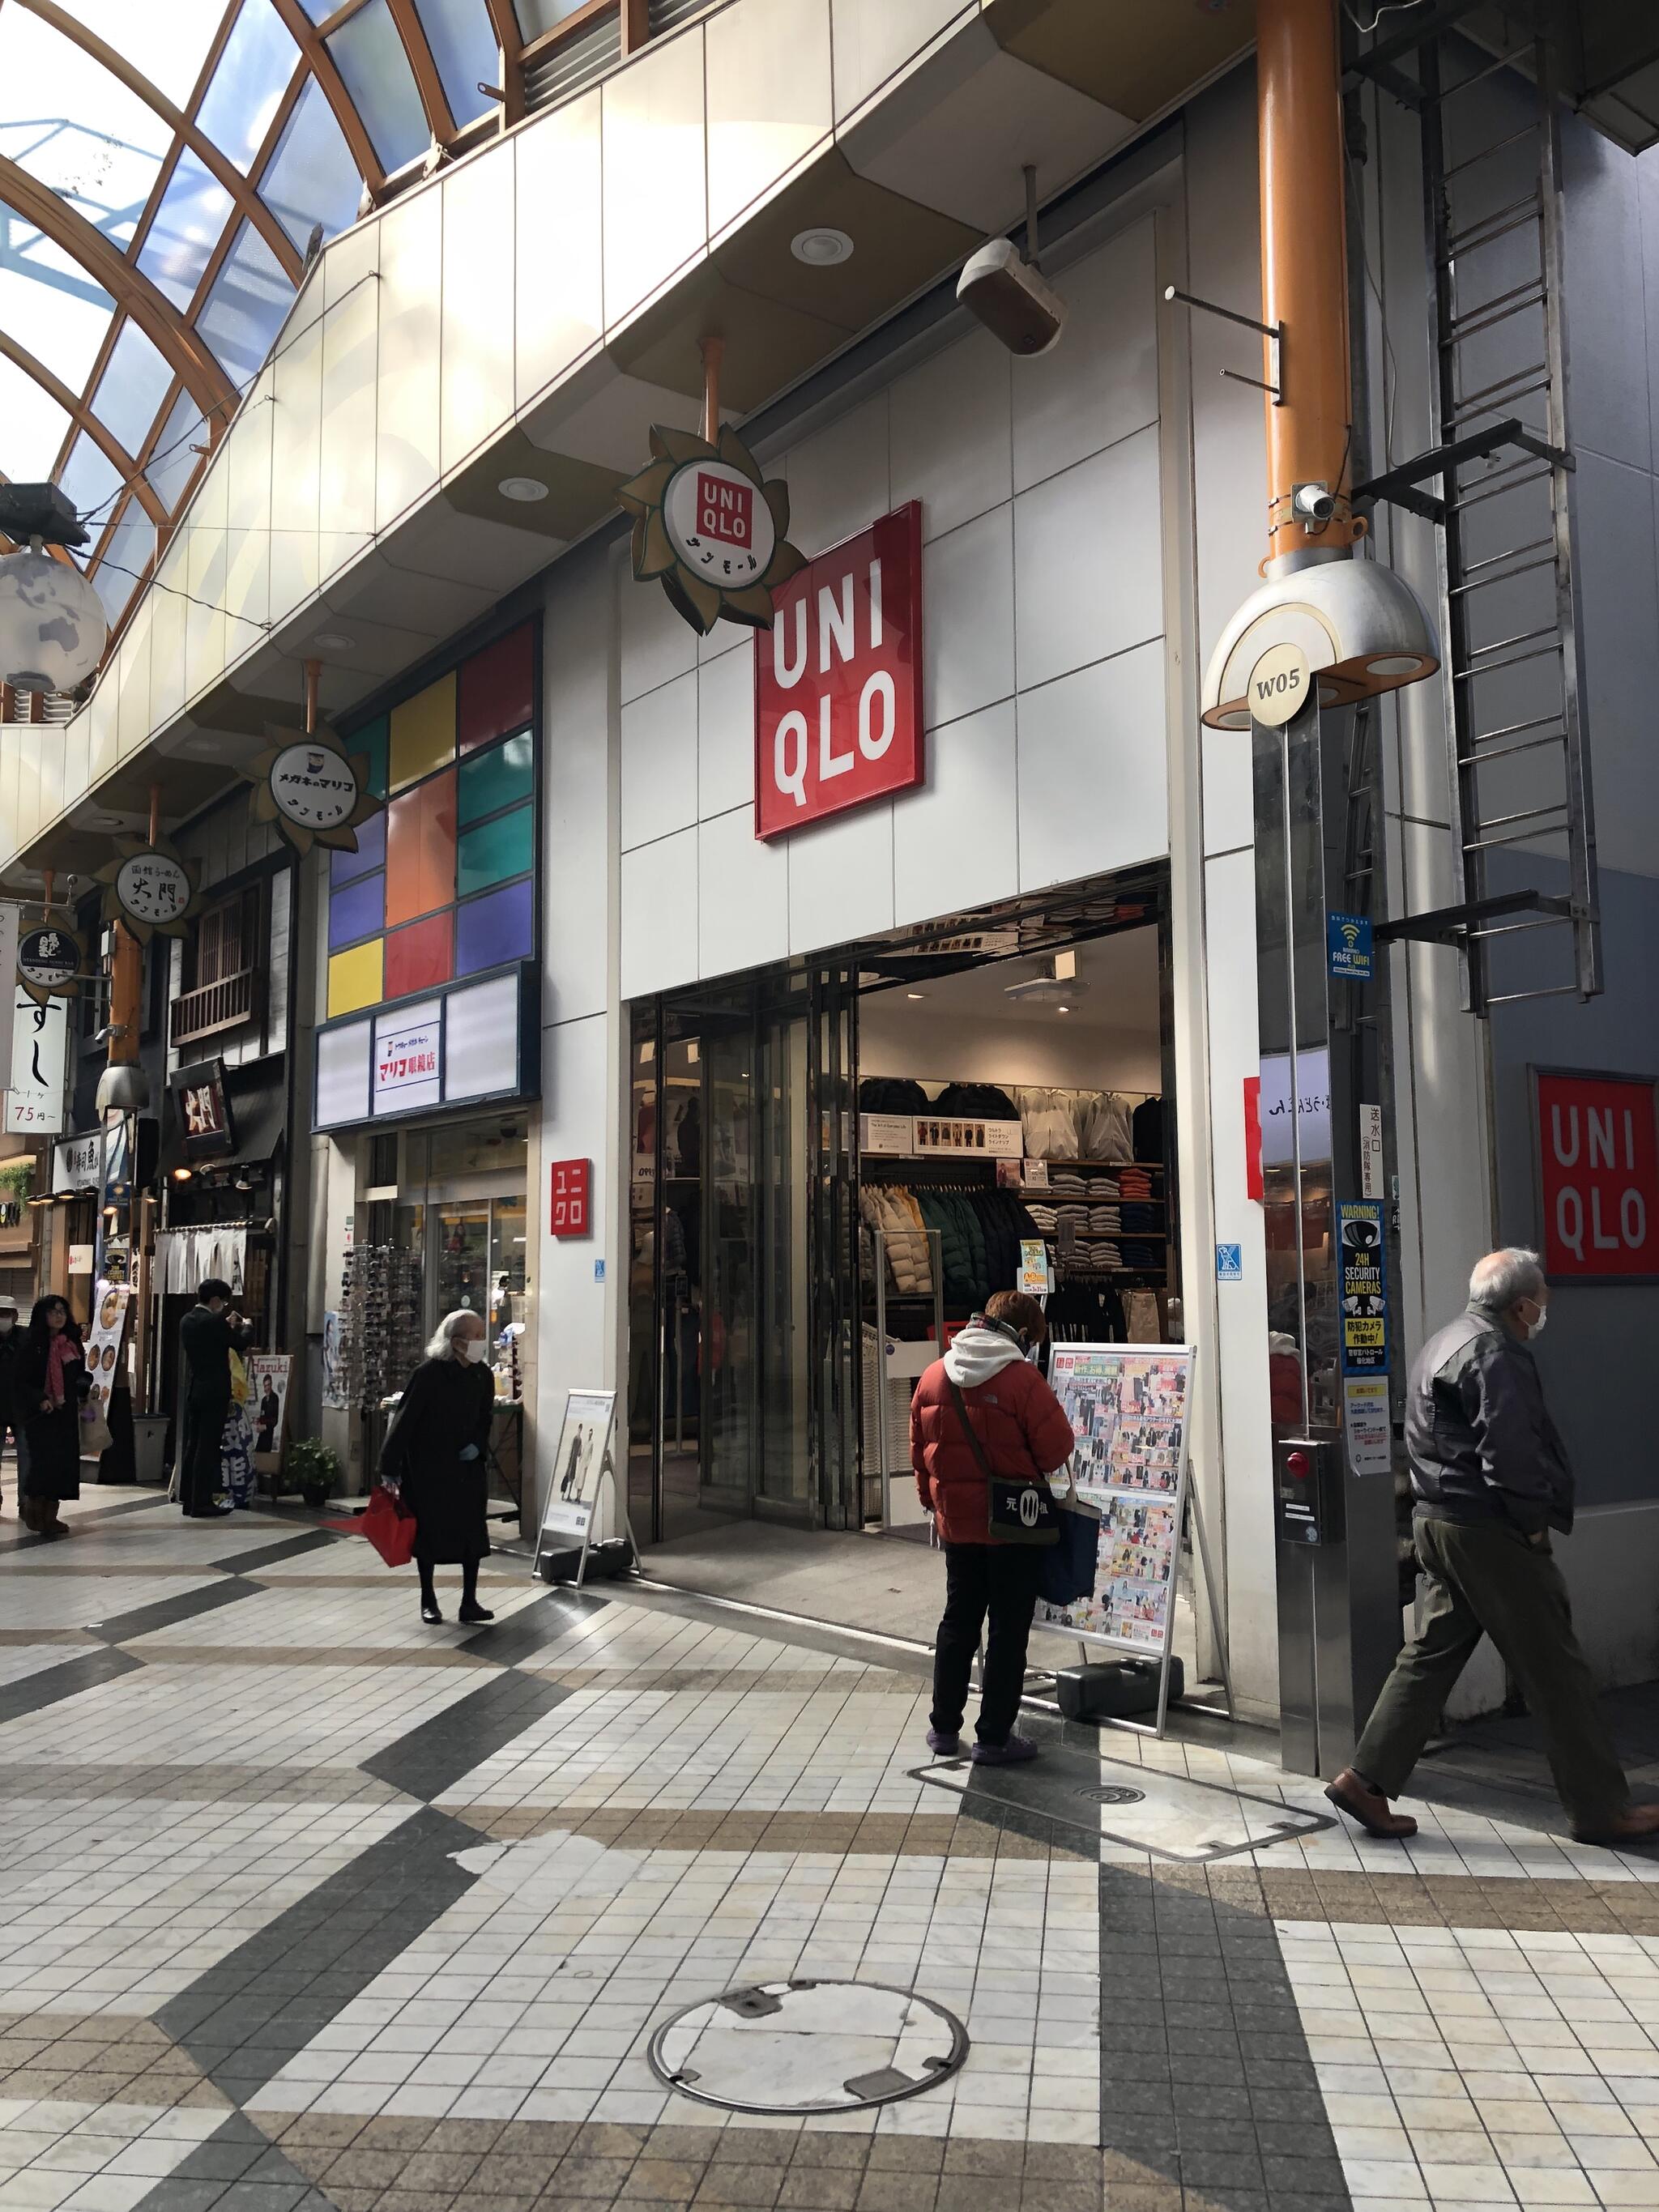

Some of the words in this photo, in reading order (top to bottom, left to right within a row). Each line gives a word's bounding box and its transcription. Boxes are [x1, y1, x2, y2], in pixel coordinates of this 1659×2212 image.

[704, 483, 743, 514] UNI
[703, 508, 746, 539] QLO
[773, 557, 883, 689] UNI
[1256, 667, 1300, 701] W05
[773, 670, 896, 808] QLO
[279, 774, 354, 792] メガネのマリコ
[132, 877, 177, 903] 大門
[1333, 952, 1351, 963] FREE
[16, 1003, 62, 1088] すし
[1371, 1107, 1380, 1152] 送水口
[1550, 1104, 1635, 1170] UNI
[556, 1169, 582, 1195] ユニ
[555, 1200, 582, 1225] クロ
[1341, 1204, 1380, 1220] WARNING!
[1555, 1186, 1646, 1262] QLO
[1355, 1252, 1370, 1266] 24H
[1345, 1267, 1380, 1280] SECURITY
[1346, 1281, 1381, 1294] CAMERAS
[1347, 1320, 1382, 1332] 防犯カメラ
[1353, 1333, 1379, 1345] 作動中!
[252, 1358, 288, 1374] Hazuki
